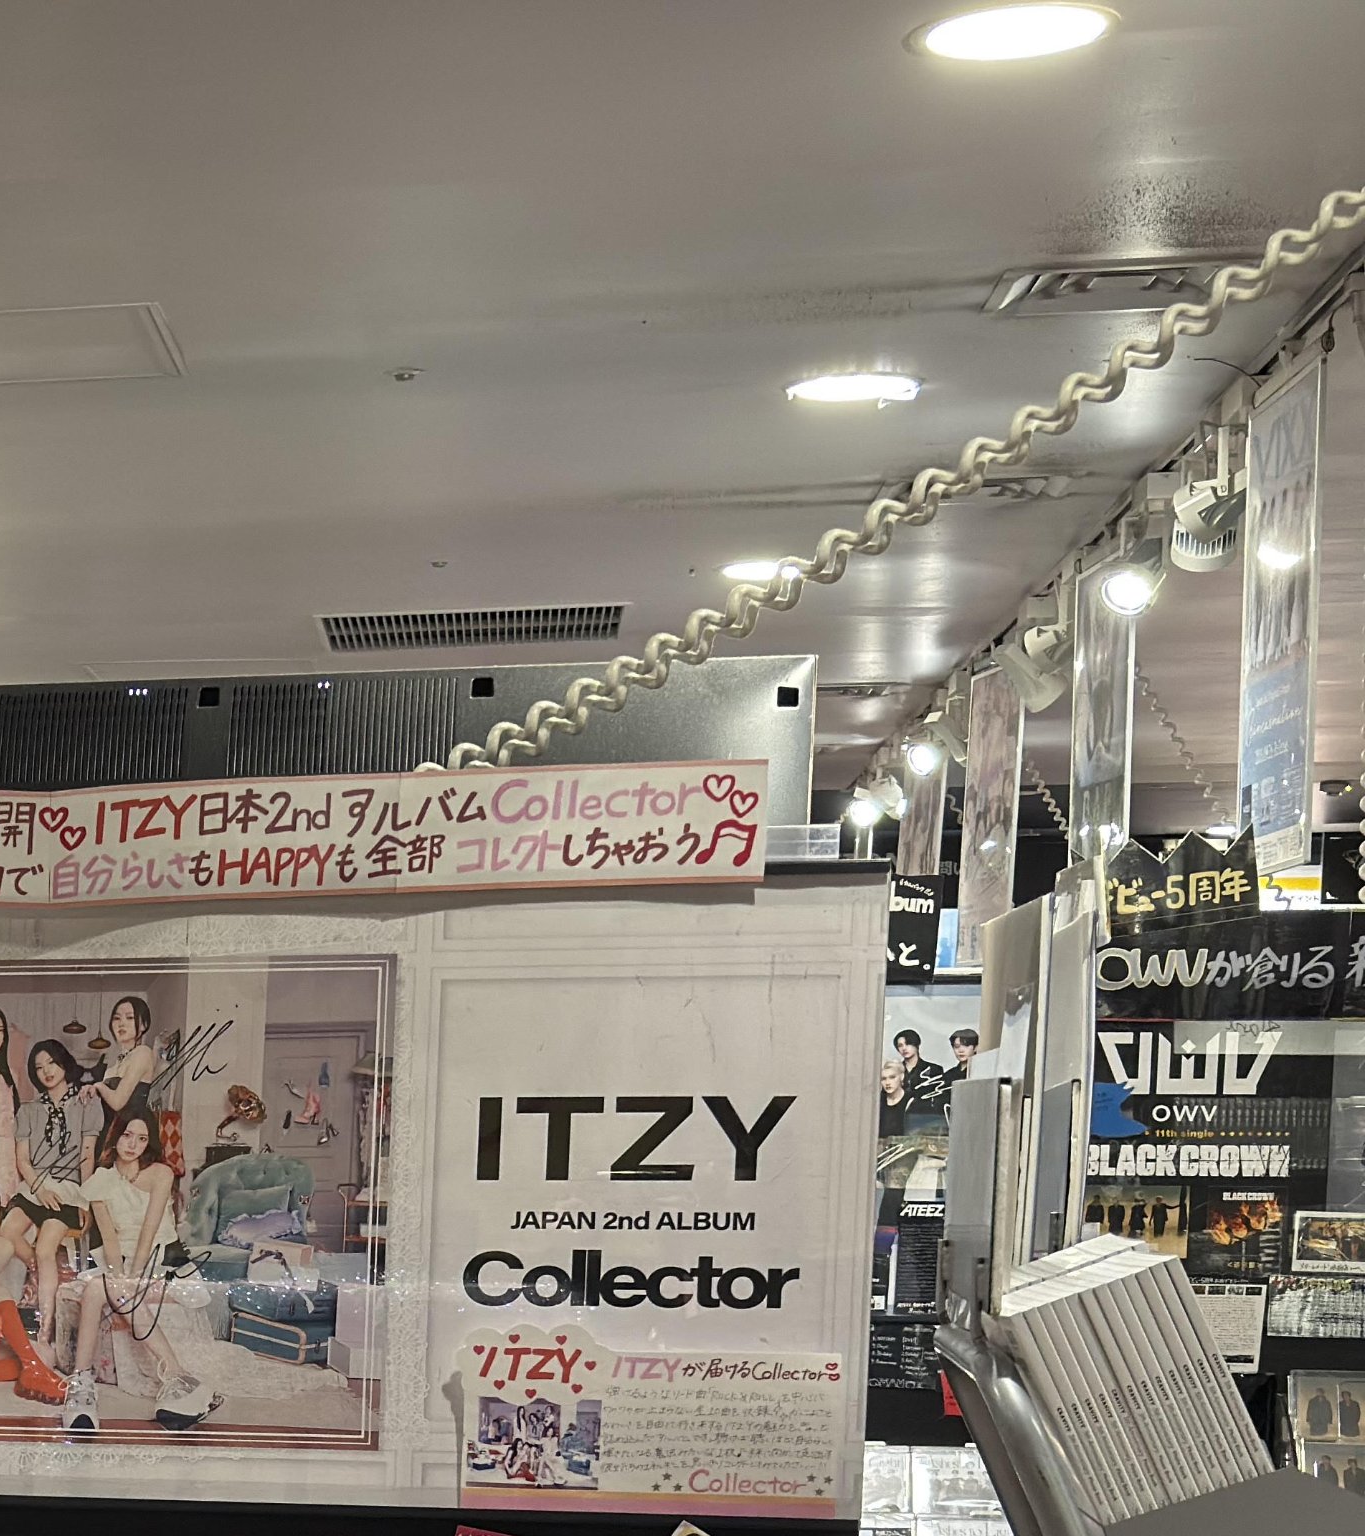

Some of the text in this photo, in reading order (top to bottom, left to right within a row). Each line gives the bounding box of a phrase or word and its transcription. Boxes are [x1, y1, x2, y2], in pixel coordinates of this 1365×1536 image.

[1152, 1104, 1217, 1122] OWV
[476, 1096, 798, 1181] ITZY
[1087, 1144, 1291, 1178] BLACK CROWN
[511, 1210, 756, 1231] JAPAN 2nd ALBUM
[900, 1203, 946, 1217] ATEEZ
[462, 1249, 801, 1309] Collector
[478, 1347, 582, 1384] ITZY
[688, 1469, 807, 1495] Collector
